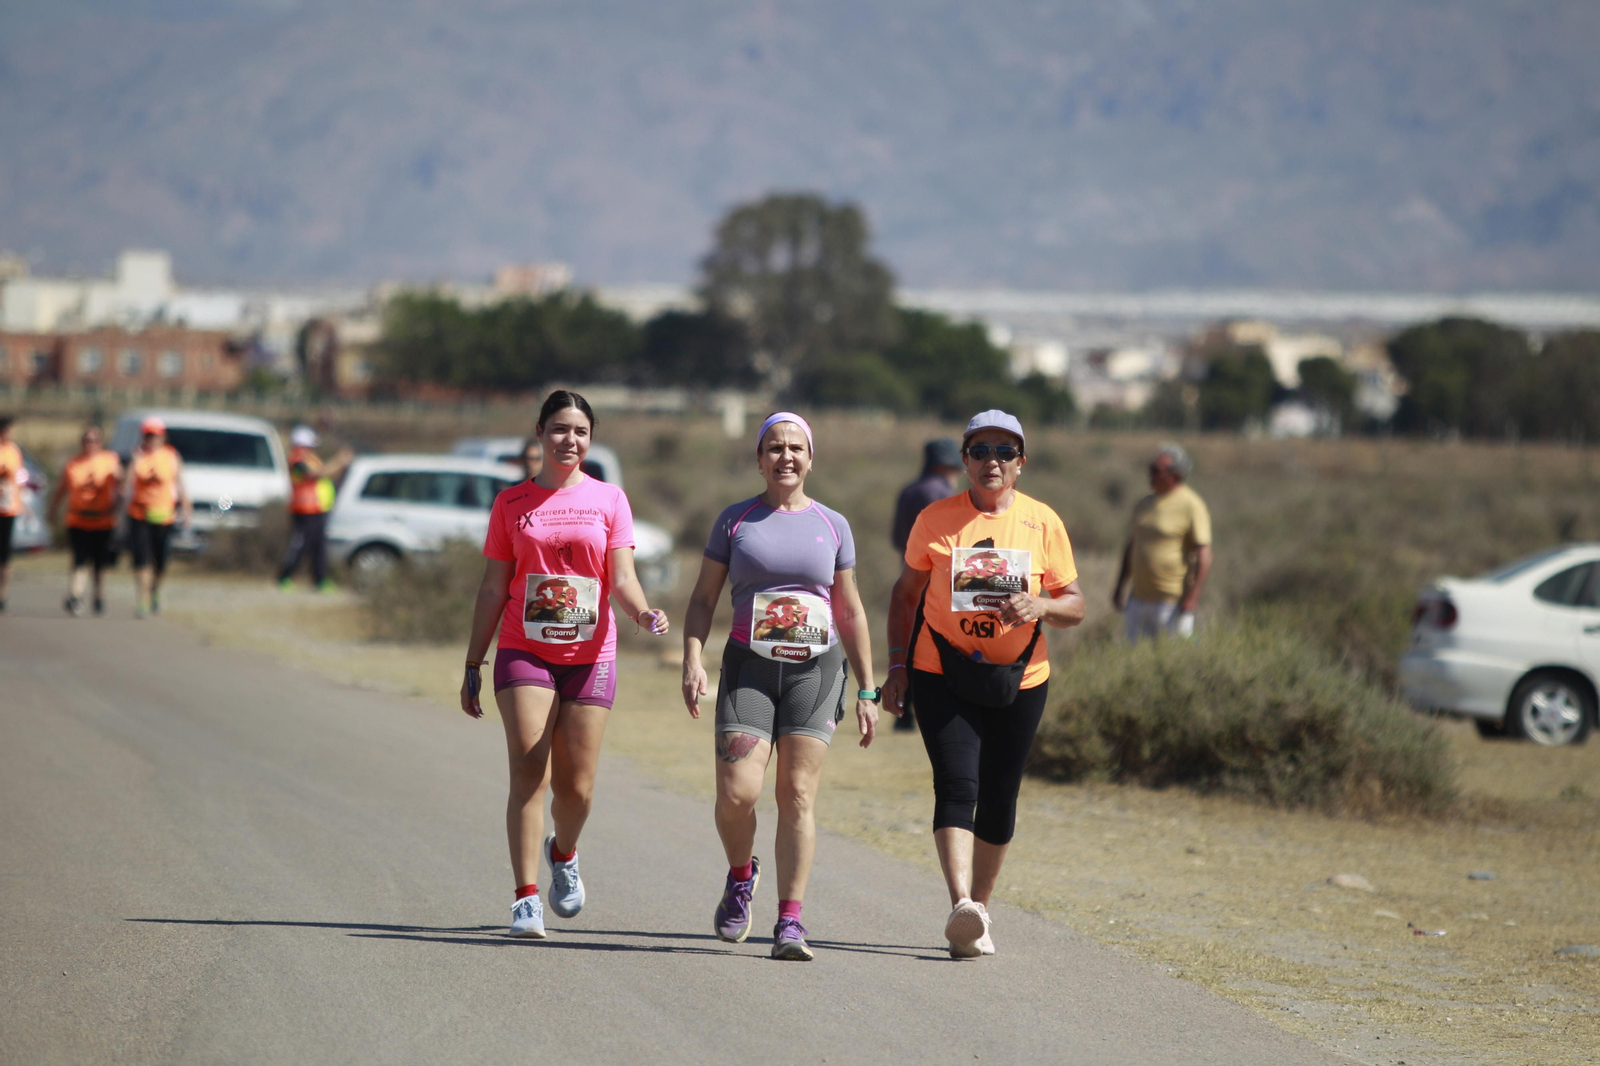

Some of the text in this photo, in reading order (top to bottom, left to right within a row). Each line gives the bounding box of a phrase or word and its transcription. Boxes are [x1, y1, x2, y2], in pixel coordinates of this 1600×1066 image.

[535, 509, 566, 517] Carrera
[569, 508, 599, 516] Popular
[964, 558, 1009, 577] 524
[535, 586, 578, 609] 578
[765, 604, 809, 627] 587
[960, 618, 995, 638] CASI
